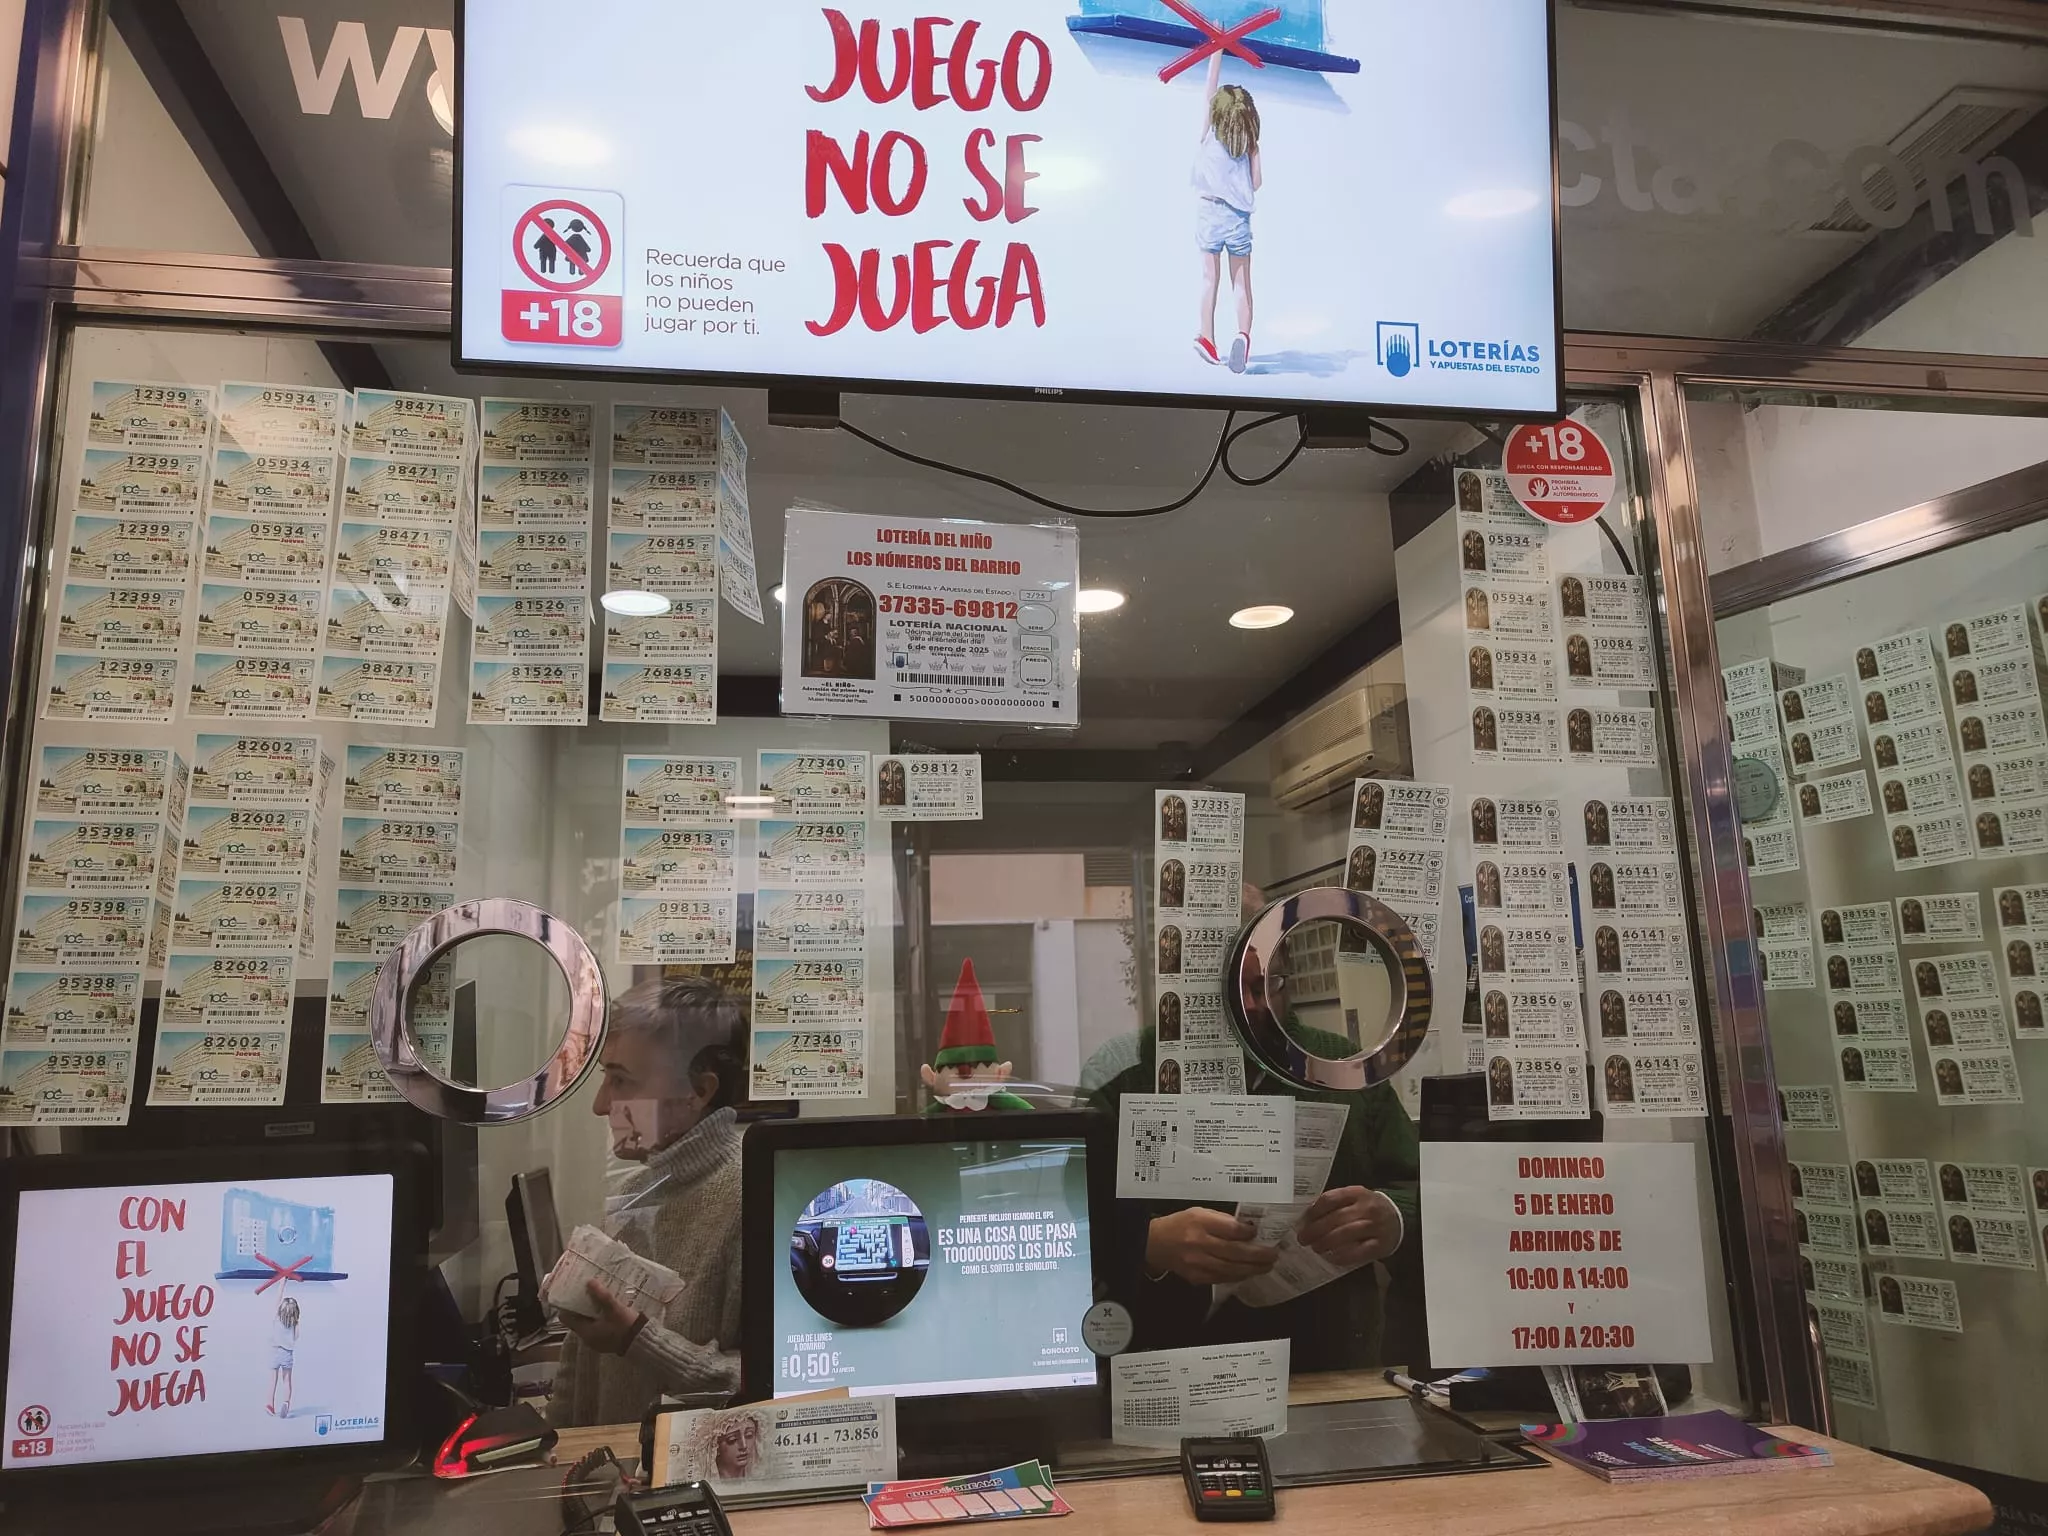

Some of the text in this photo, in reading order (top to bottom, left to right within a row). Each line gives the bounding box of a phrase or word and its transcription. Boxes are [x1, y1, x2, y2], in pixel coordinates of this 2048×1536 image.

[804, 8, 1052, 112] JUEGO
[804, 128, 1043, 224] NO SE
[646, 249, 786, 274] Recuerda que
[646, 271, 733, 292] los niños
[804, 240, 1045, 337] JUEGA
[646, 295, 754, 317] no pueden
[519, 299, 603, 338] +18
[644, 316, 760, 335] jugar por ti.
[1429, 339, 1540, 362] LOTERÍAS
[1430, 360, 1540, 375] Y APUESTAS DEL ESTADO
[134, 387, 187, 403] 12399
[1035, 387, 1063, 396] PHILIPS
[394, 399, 446, 415] 98471
[1525, 427, 1585, 461] +18
[256, 457, 311, 472] 05934
[518, 469, 569, 483] 81526
[648, 537, 695, 549] 76845
[877, 528, 992, 549] LOTERÍA DEL NIÑO
[847, 551, 1021, 575] LOS NÚMEROS DEL BARRIO
[940, 585, 972, 593] APUESTAS
[986, 588, 1011, 596] ESTADO
[1588, 580, 1627, 591] 10084
[879, 595, 1018, 620] 37335-69812
[890, 620, 1007, 632] LOTERÍA NACIONAL
[956, 645, 966, 653] de
[969, 646, 989, 654] 2025
[99, 659, 154, 675] 12399
[236, 658, 291, 674] 05934
[361, 662, 414, 678] 98471
[1498, 711, 1541, 724] 05934
[1596, 713, 1637, 724] 10684
[237, 739, 294, 754] 82602
[86, 751, 143, 766] 95398
[386, 752, 440, 766] 83219
[911, 763, 958, 774] 69812
[1390, 788, 1432, 801] 15677
[1191, 799, 1231, 810] 37335
[1500, 802, 1542, 814] 73856
[1612, 804, 1654, 815] 46141
[796, 825, 844, 836] 77340
[662, 833, 713, 844] 09813
[59, 976, 116, 991] 95398
[1511, 994, 1557, 1005] 73856
[204, 1034, 261, 1049] 82602
[792, 1035, 842, 1046] 77340
[1634, 1058, 1680, 1070] 46141
[1518, 1157, 1604, 1178] DOMINGO
[1514, 1194, 1614, 1216] 5 DE ENERO
[119, 1196, 186, 1233] CON
[1036, 1212, 1042, 1220] EL
[1043, 1211, 1054, 1219] GPS
[938, 1223, 1077, 1245] ES UNA COSA QUE PASA
[1510, 1230, 1622, 1252] ABRIMOS DE
[1019, 1242, 1041, 1260] LOS
[1045, 1240, 1076, 1258] DÍAS.
[115, 1240, 153, 1280] EL
[962, 1264, 980, 1275] COMO
[981, 1264, 988, 1273] EL
[990, 1263, 1014, 1273] SORTEO
[1016, 1263, 1024, 1272] DE
[1506, 1267, 1629, 1290] 10:00 A 14:00
[113, 1284, 214, 1326] JUEGO
[1568, 1302, 1574, 1314] Y
[787, 1333, 832, 1343] JUEGA DE LUNES
[1512, 1325, 1634, 1349] 17:00 A 20:30
[111, 1325, 209, 1371] NO SE
[794, 1344, 798, 1352] A
[1041, 1346, 1079, 1355] BONOLOTO
[108, 1369, 206, 1417] JUEGA
[335, 1416, 379, 1427] LOTERÍAS
[775, 1432, 818, 1447] 46.141
[834, 1427, 878, 1442] 73.856
[18, 1441, 46, 1454] +18
